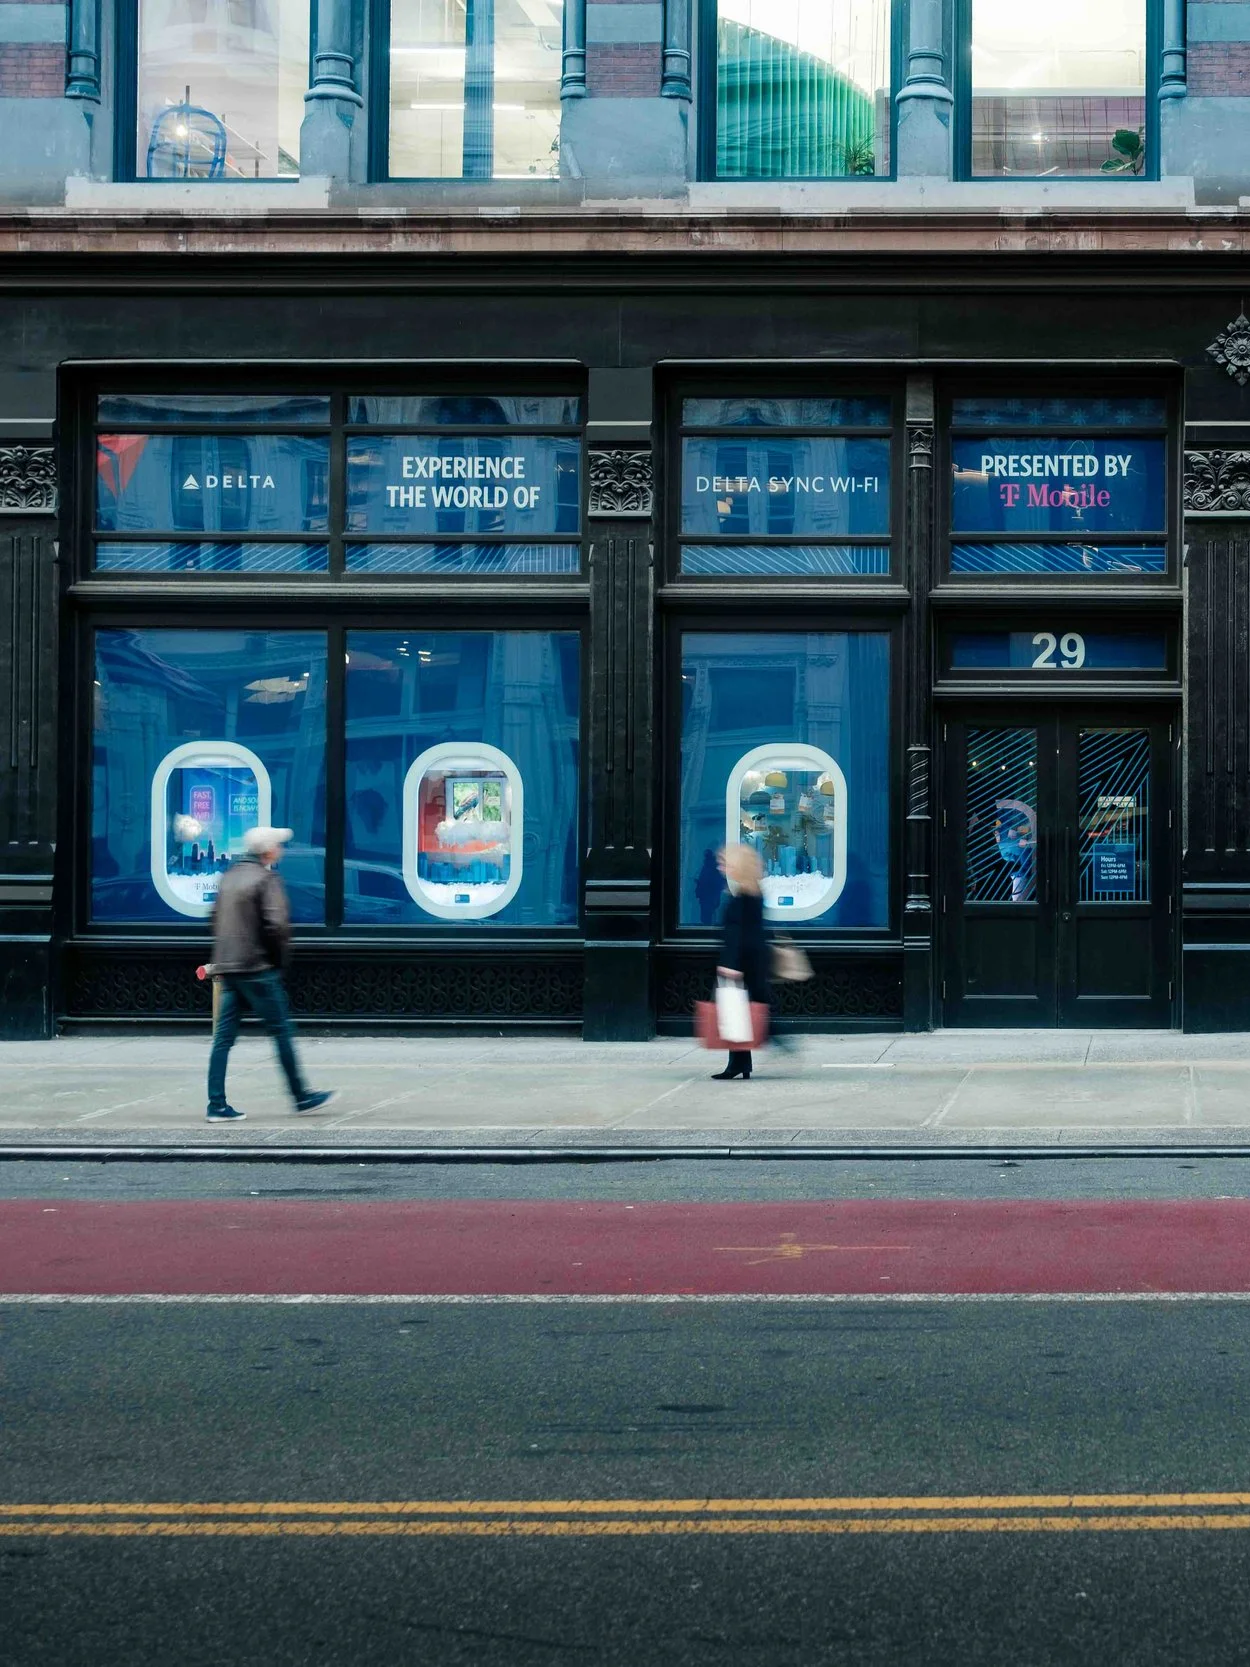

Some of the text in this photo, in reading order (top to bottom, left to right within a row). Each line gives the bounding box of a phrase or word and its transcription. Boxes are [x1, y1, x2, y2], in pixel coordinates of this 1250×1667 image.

[402, 456, 525, 479] EXPERIENCE
[981, 455, 1132, 477] PRESENTED BY
[206, 475, 275, 489] DELTA
[696, 476, 878, 493] DELTA SYNC WI-FI
[386, 485, 541, 508] THE WORLD OF
[1027, 483, 1111, 507] Mobile
[1031, 632, 1086, 668] 29
